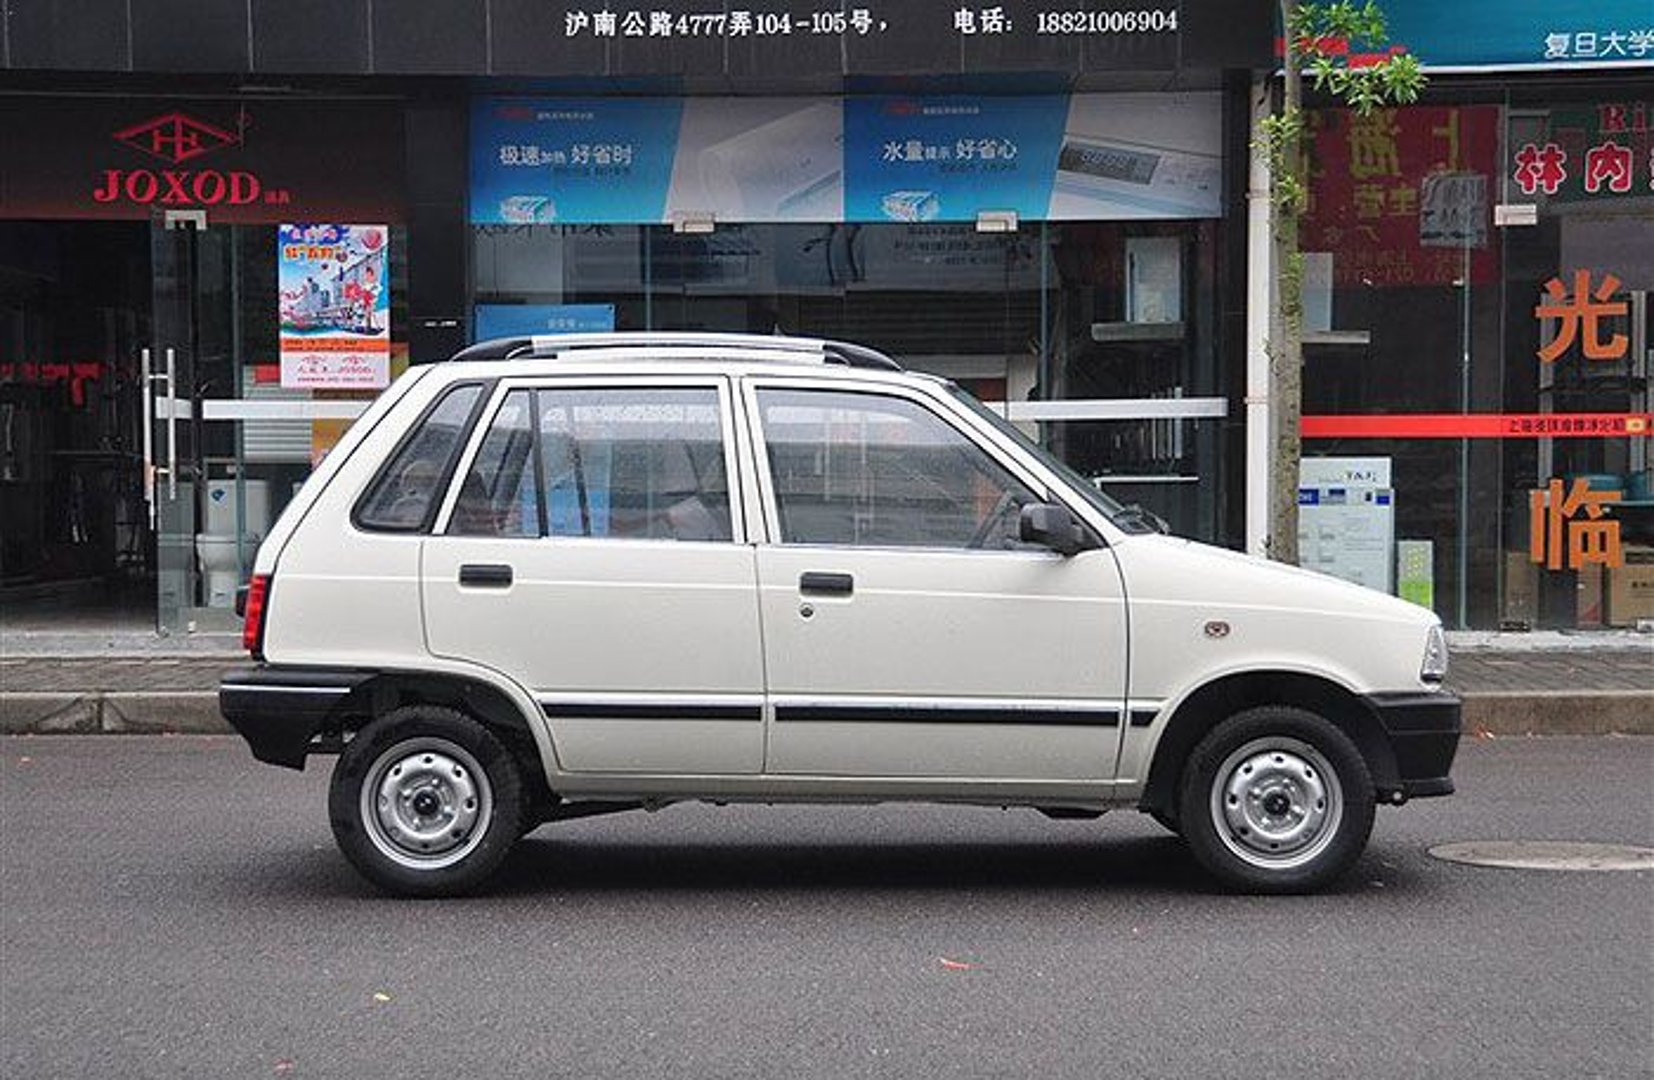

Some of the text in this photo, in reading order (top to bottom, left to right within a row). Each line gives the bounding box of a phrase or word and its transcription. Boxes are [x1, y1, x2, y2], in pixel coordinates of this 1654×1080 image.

[1036, 10, 1178, 33] 18821006904
[1544, 30, 1654, 59] 复旦大学
[571, 144, 631, 165] 好省时
[956, 139, 1017, 160] 好省心
[1514, 141, 1654, 194] 林内
[93, 169, 261, 204] JOXOD
